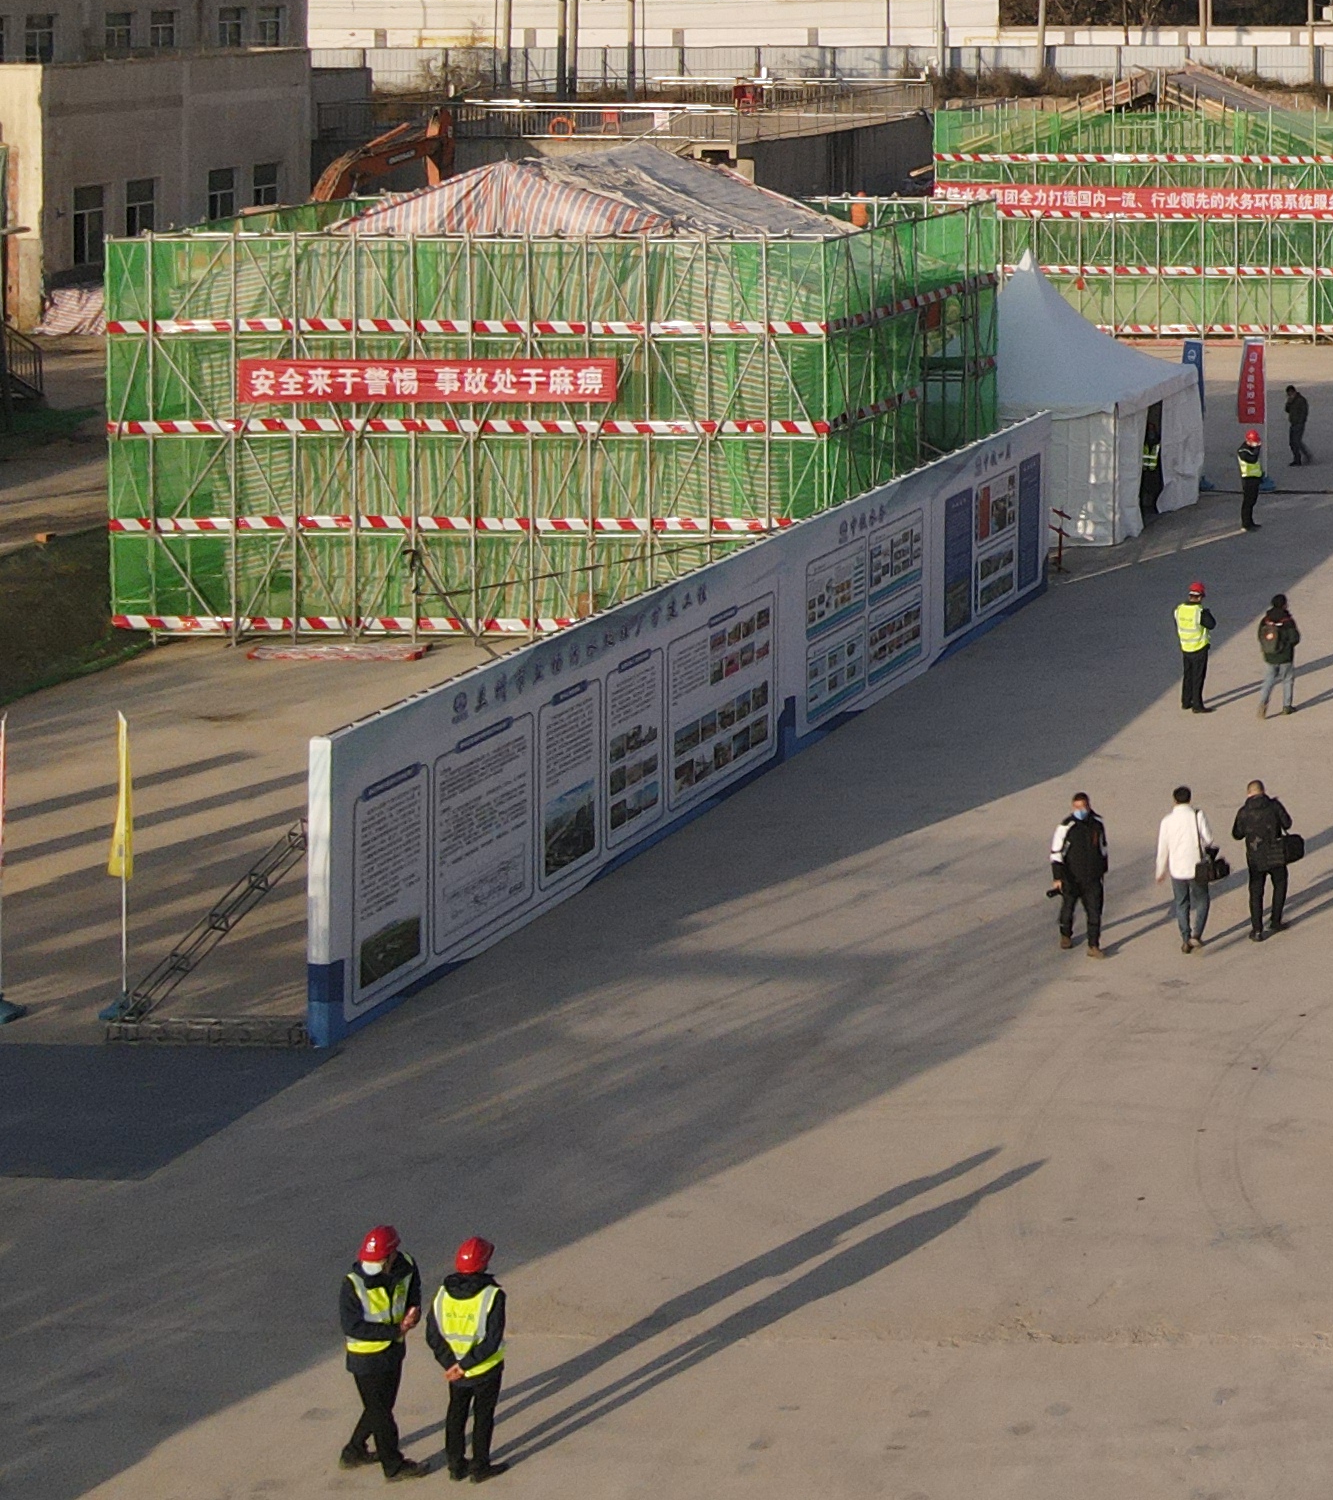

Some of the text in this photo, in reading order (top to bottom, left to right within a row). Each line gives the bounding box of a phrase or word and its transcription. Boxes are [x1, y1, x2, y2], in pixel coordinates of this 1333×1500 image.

[250, 368, 419, 396] 安全来于警惕
